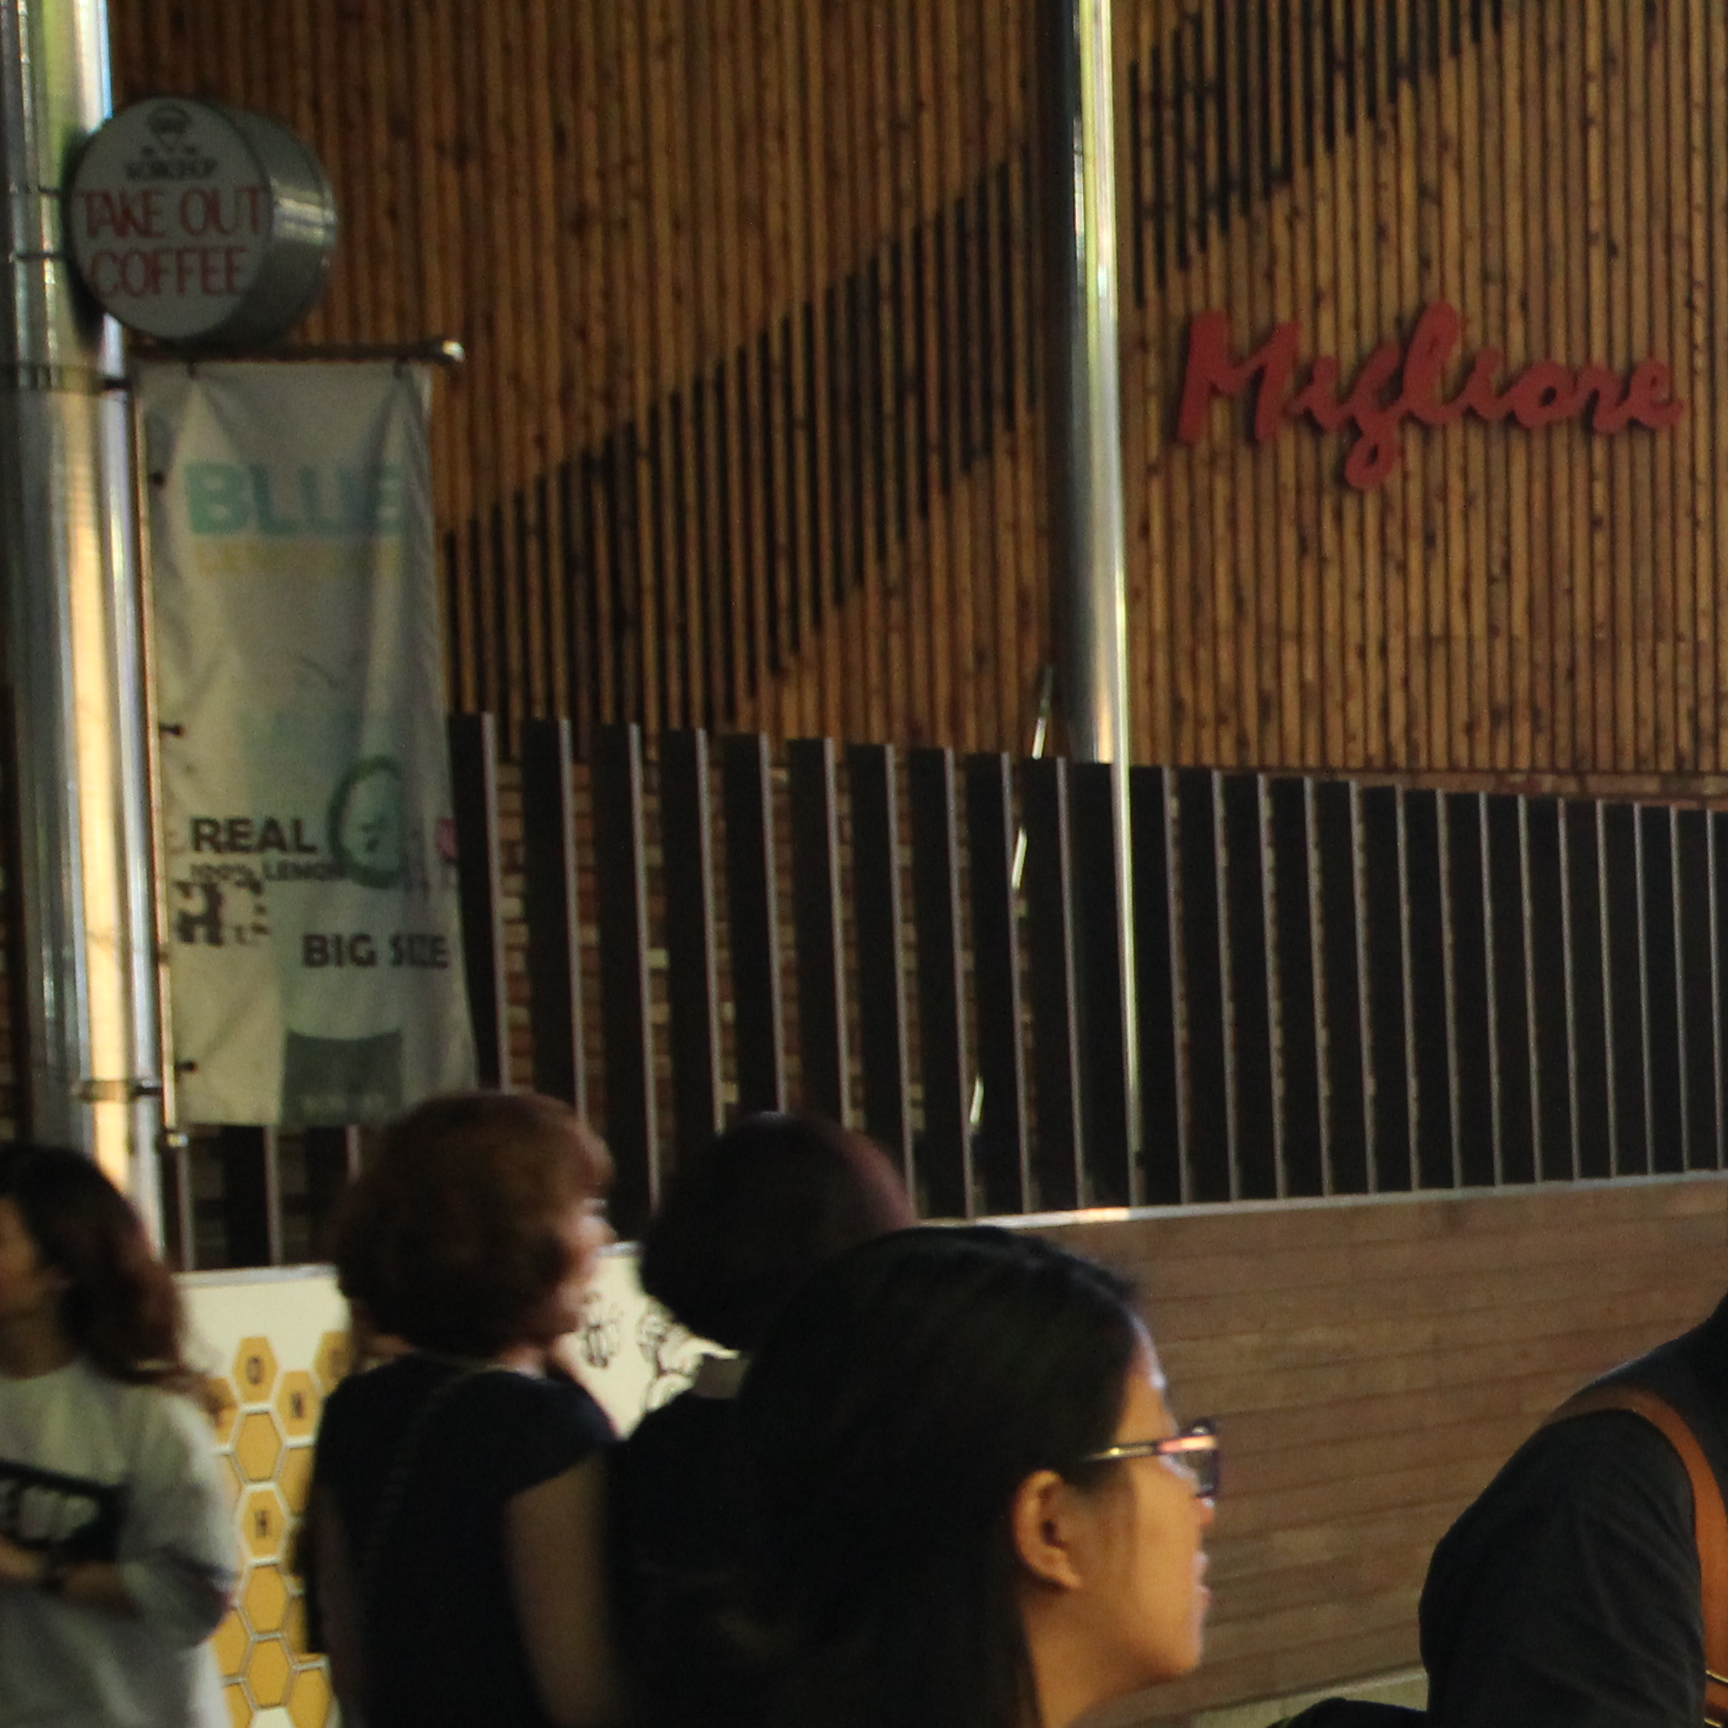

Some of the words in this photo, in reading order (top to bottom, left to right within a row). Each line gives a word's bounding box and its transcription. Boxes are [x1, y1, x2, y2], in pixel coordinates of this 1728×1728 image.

[81, 186, 165, 239] TAKE
[179, 185, 263, 237] OUT
[89, 247, 248, 298] COFFEE
[184, 462, 403, 537] BLUE
[190, 816, 318, 853] REAL
[303, 932, 377, 969] BIG
